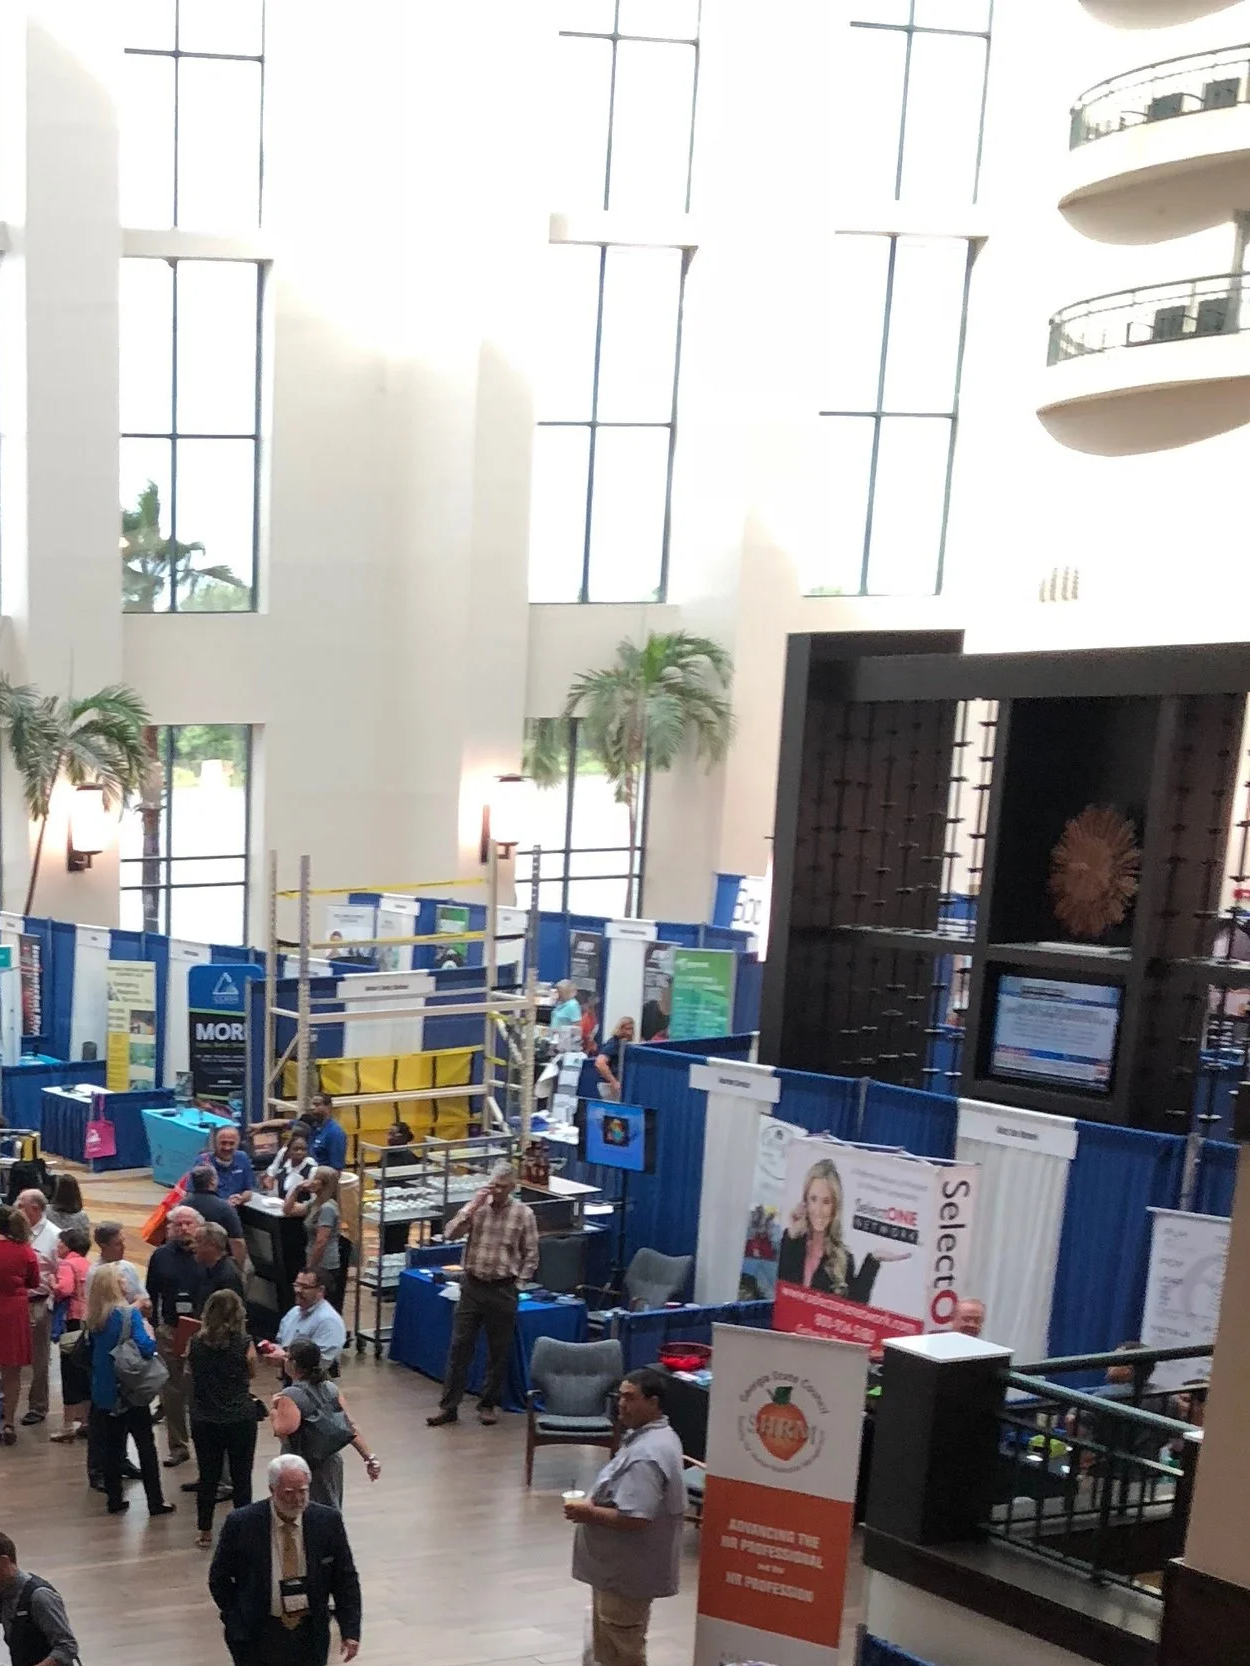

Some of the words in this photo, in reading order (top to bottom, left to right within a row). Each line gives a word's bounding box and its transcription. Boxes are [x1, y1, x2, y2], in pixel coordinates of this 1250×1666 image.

[195, 1023, 246, 1041] MOR
[748, 1412, 818, 1446] SHRM
[739, 1538, 824, 1570] PROFESSIONAL
[797, 1532, 821, 1550] THE
[743, 1575, 815, 1604] PROFESSION
